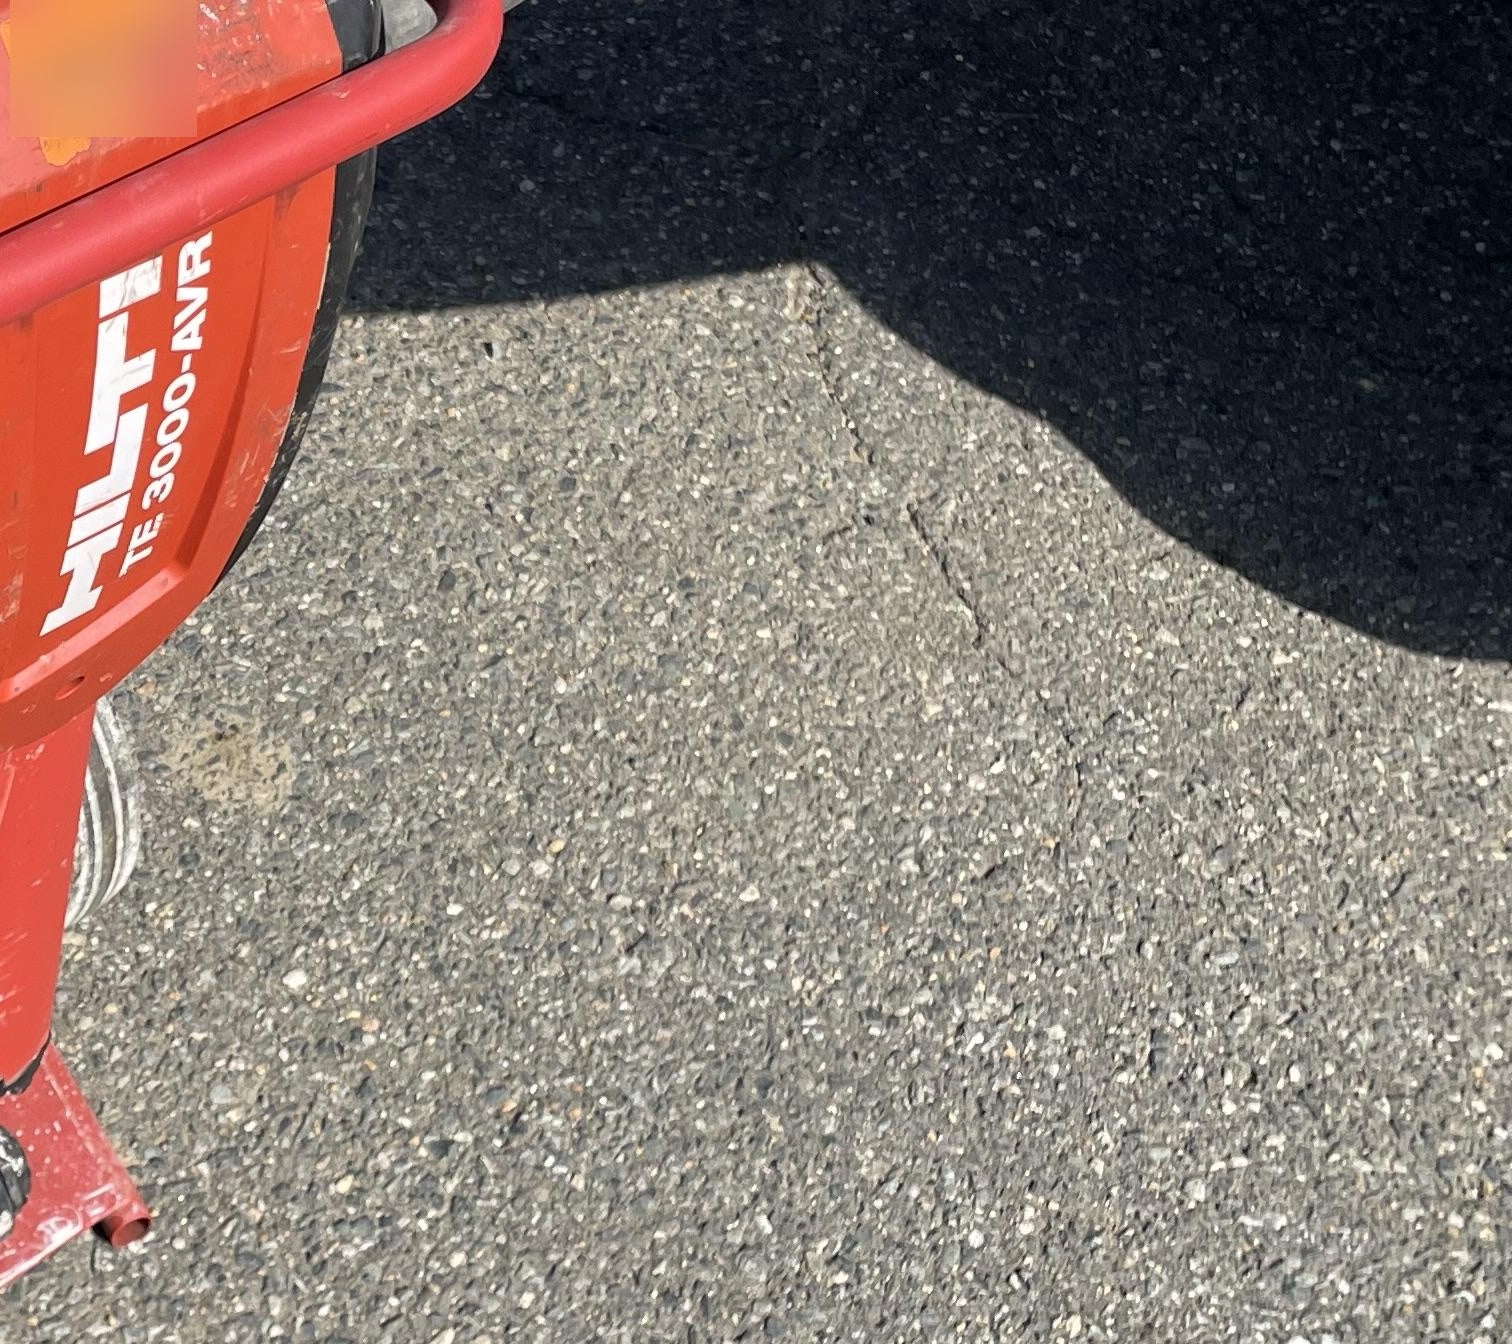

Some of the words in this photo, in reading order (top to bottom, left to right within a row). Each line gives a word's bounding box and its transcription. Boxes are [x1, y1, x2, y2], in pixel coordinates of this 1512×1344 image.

[40, 255, 164, 637] HILTI
[141, 231, 214, 511] 3000-AVR
[119, 515, 165, 578] TE
